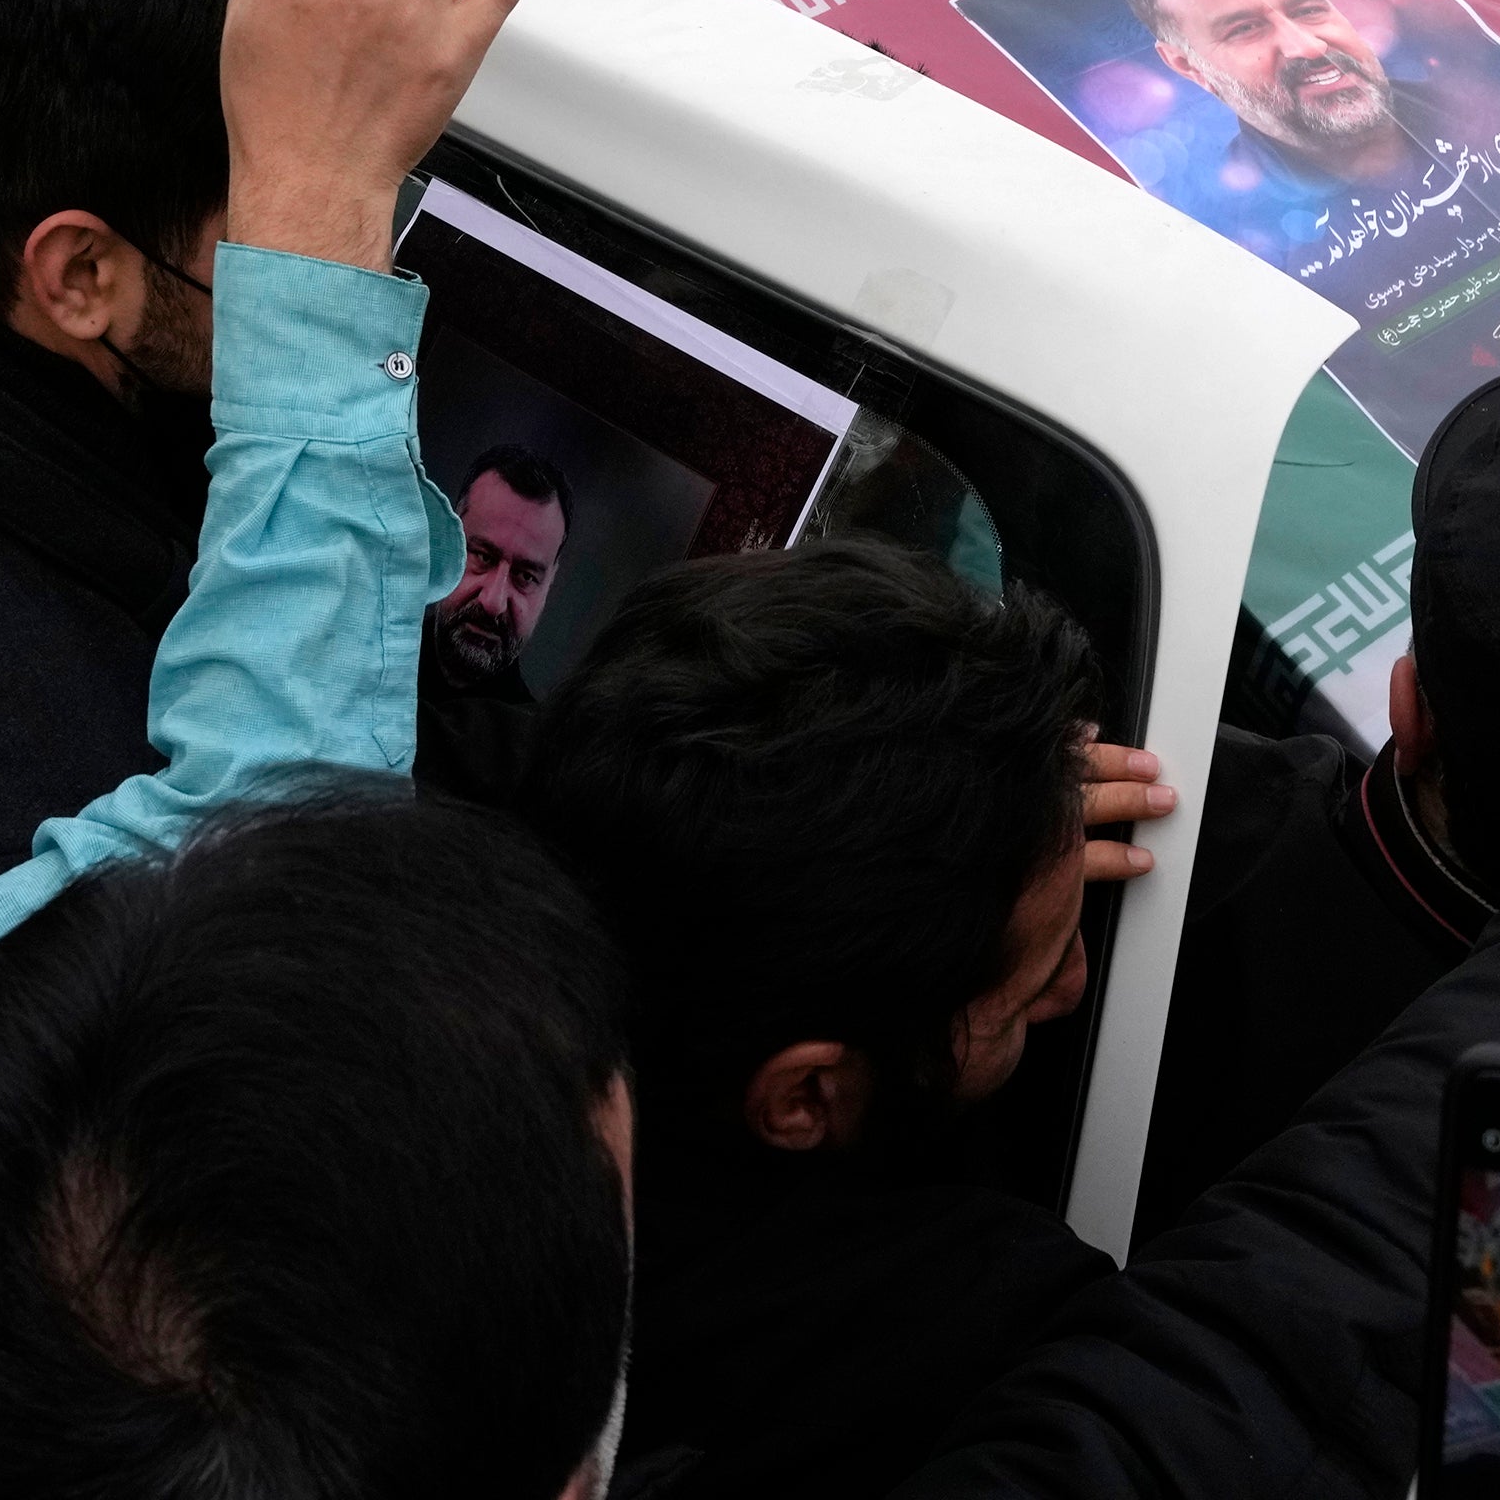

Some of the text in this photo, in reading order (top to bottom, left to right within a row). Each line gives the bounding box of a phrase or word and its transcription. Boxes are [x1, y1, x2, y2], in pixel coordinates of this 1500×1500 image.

[1470, 152, 1493, 184] از
[1379, 138, 1470, 238] شهیدان
[1315, 207, 1345, 267] آمد
[1348, 198, 1380, 257] خواهد
[1456, 232, 1488, 258] سردار
[1432, 250, 1458, 268] سید
[1408, 264, 1437, 287] رضی
[1364, 279, 1406, 310] موسوی
[1462, 277, 1483, 303] ظهور
[1422, 294, 1460, 318] حضرت
[1396, 314, 1421, 334] حجت
